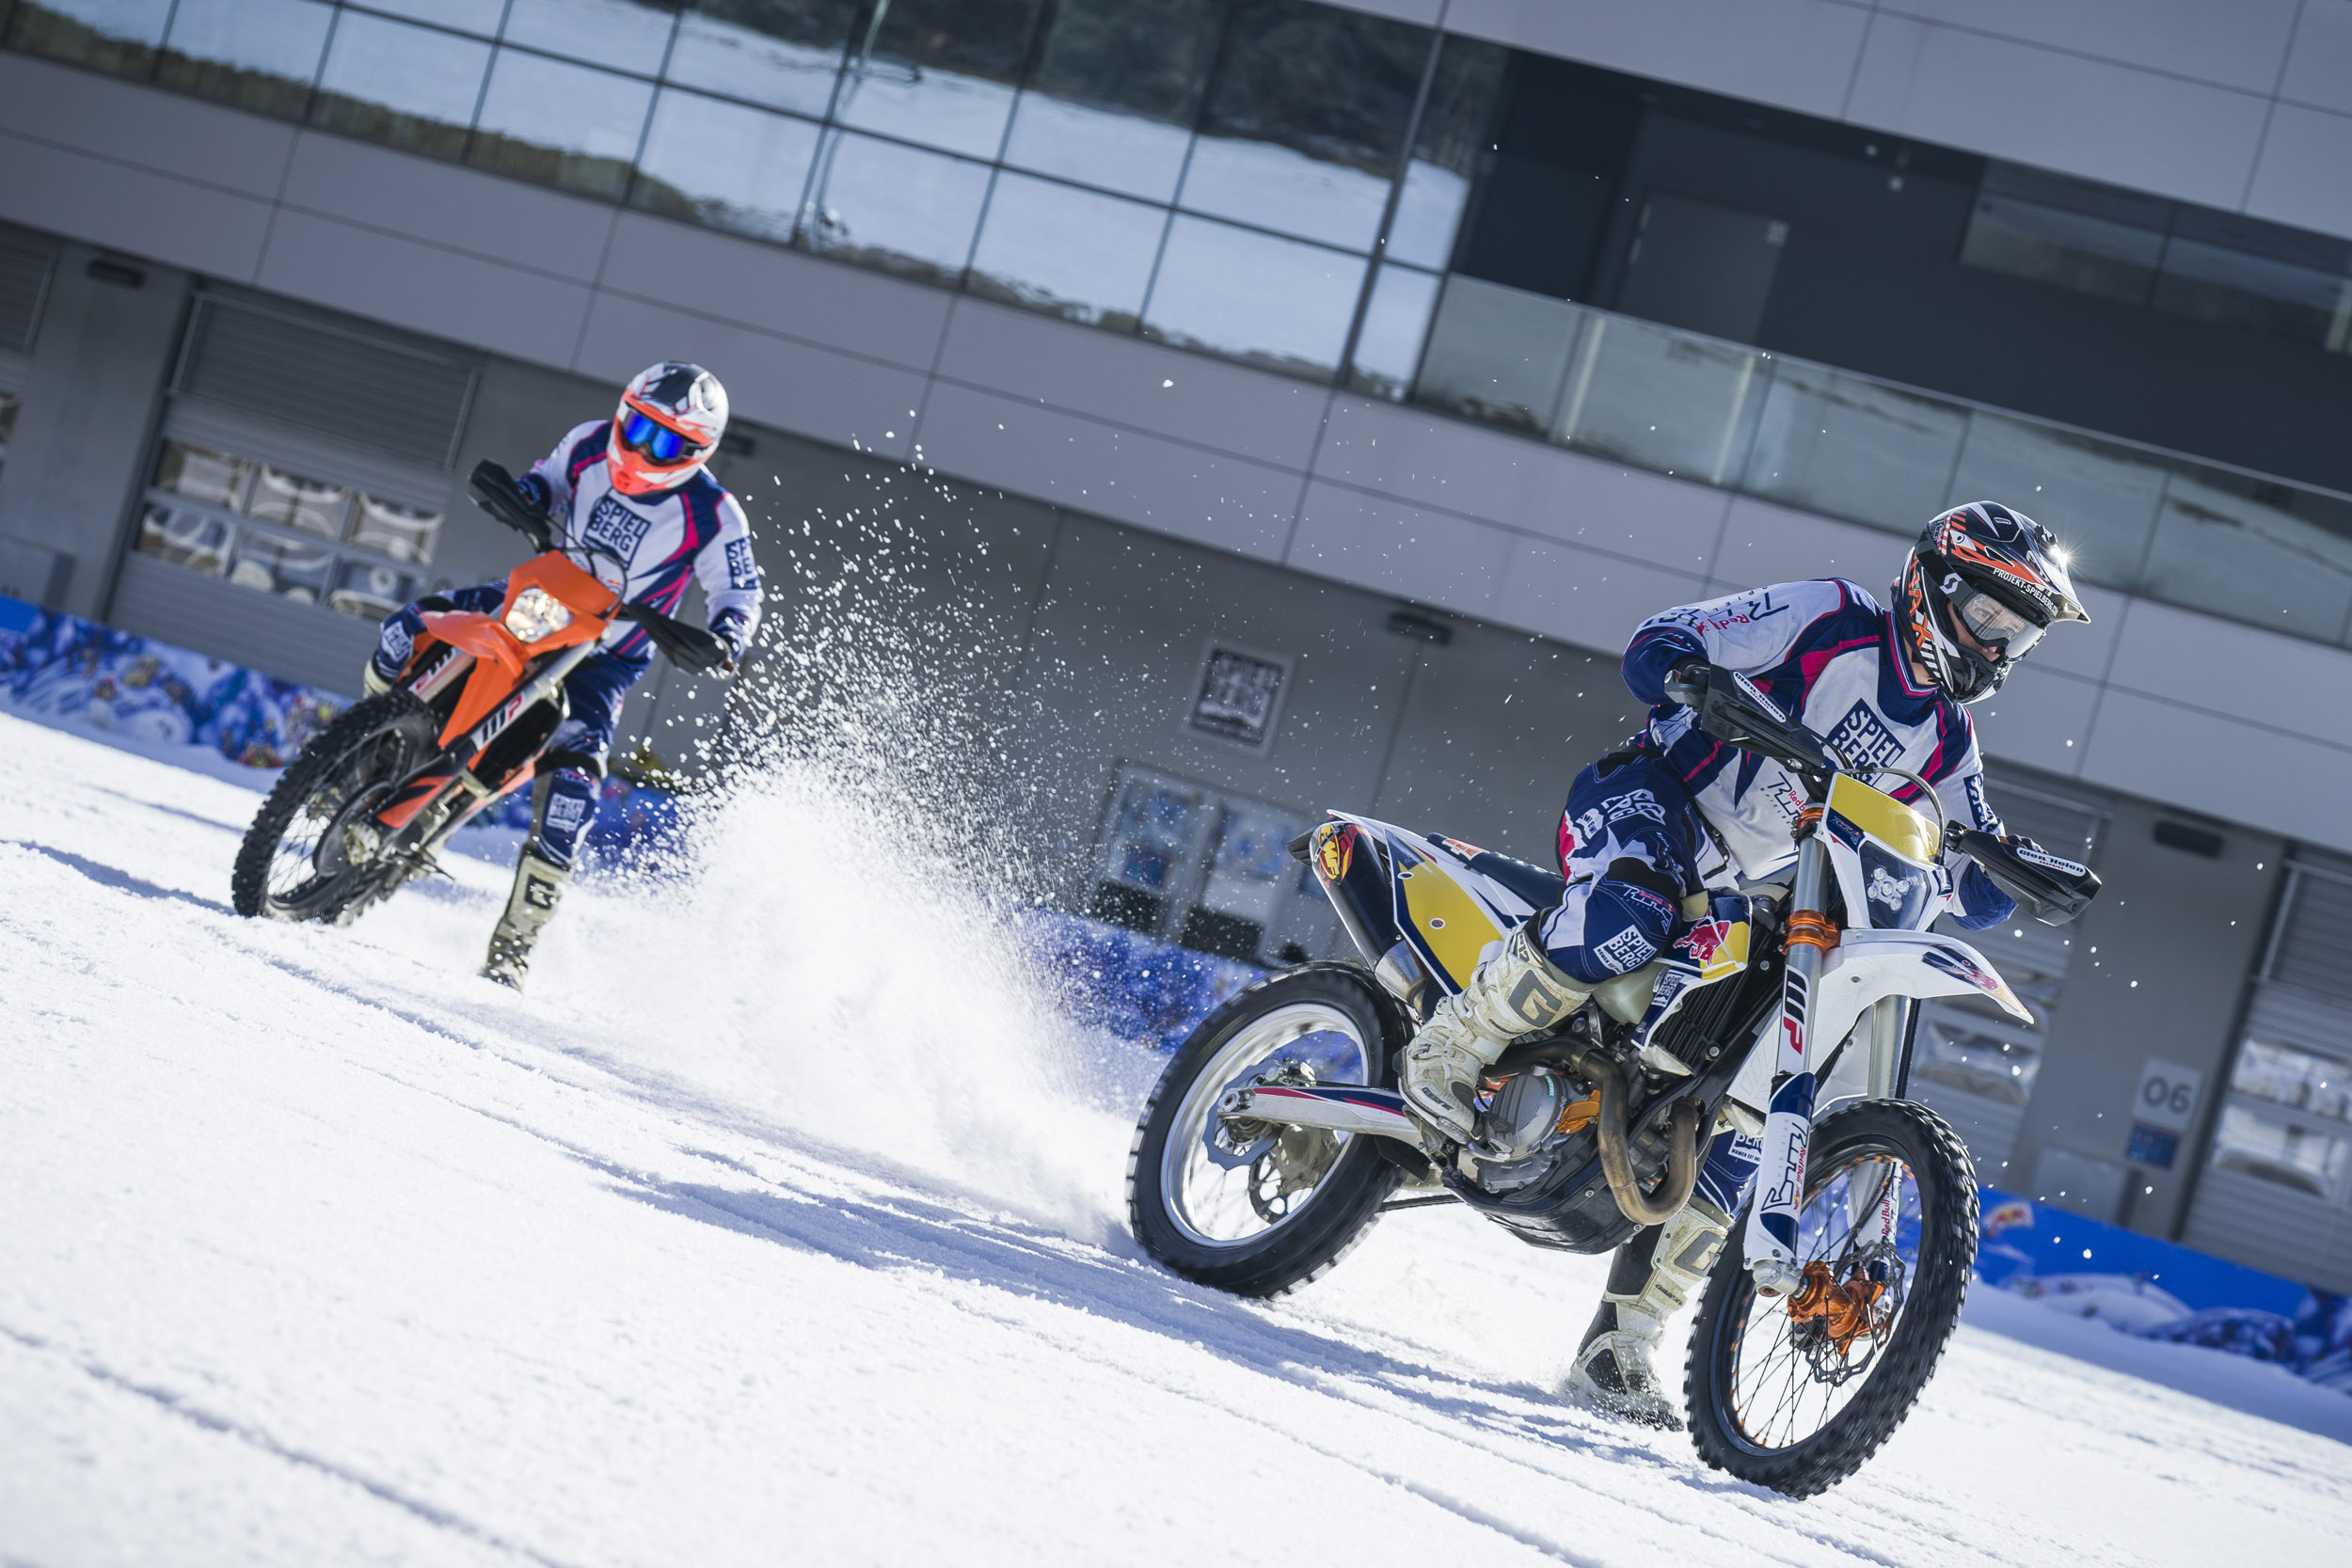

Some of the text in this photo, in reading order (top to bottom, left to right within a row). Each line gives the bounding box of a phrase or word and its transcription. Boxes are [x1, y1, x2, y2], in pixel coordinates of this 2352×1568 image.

[589, 511, 632, 552] BERG
[597, 499, 647, 537] SPIEL
[1847, 710, 1901, 768] SPIEL
[1607, 938, 1641, 968] BERG
[1622, 931, 1655, 960] SPIEL
[2142, 1075, 2192, 1116] 06
[1882, 1216, 1890, 1236] Red
